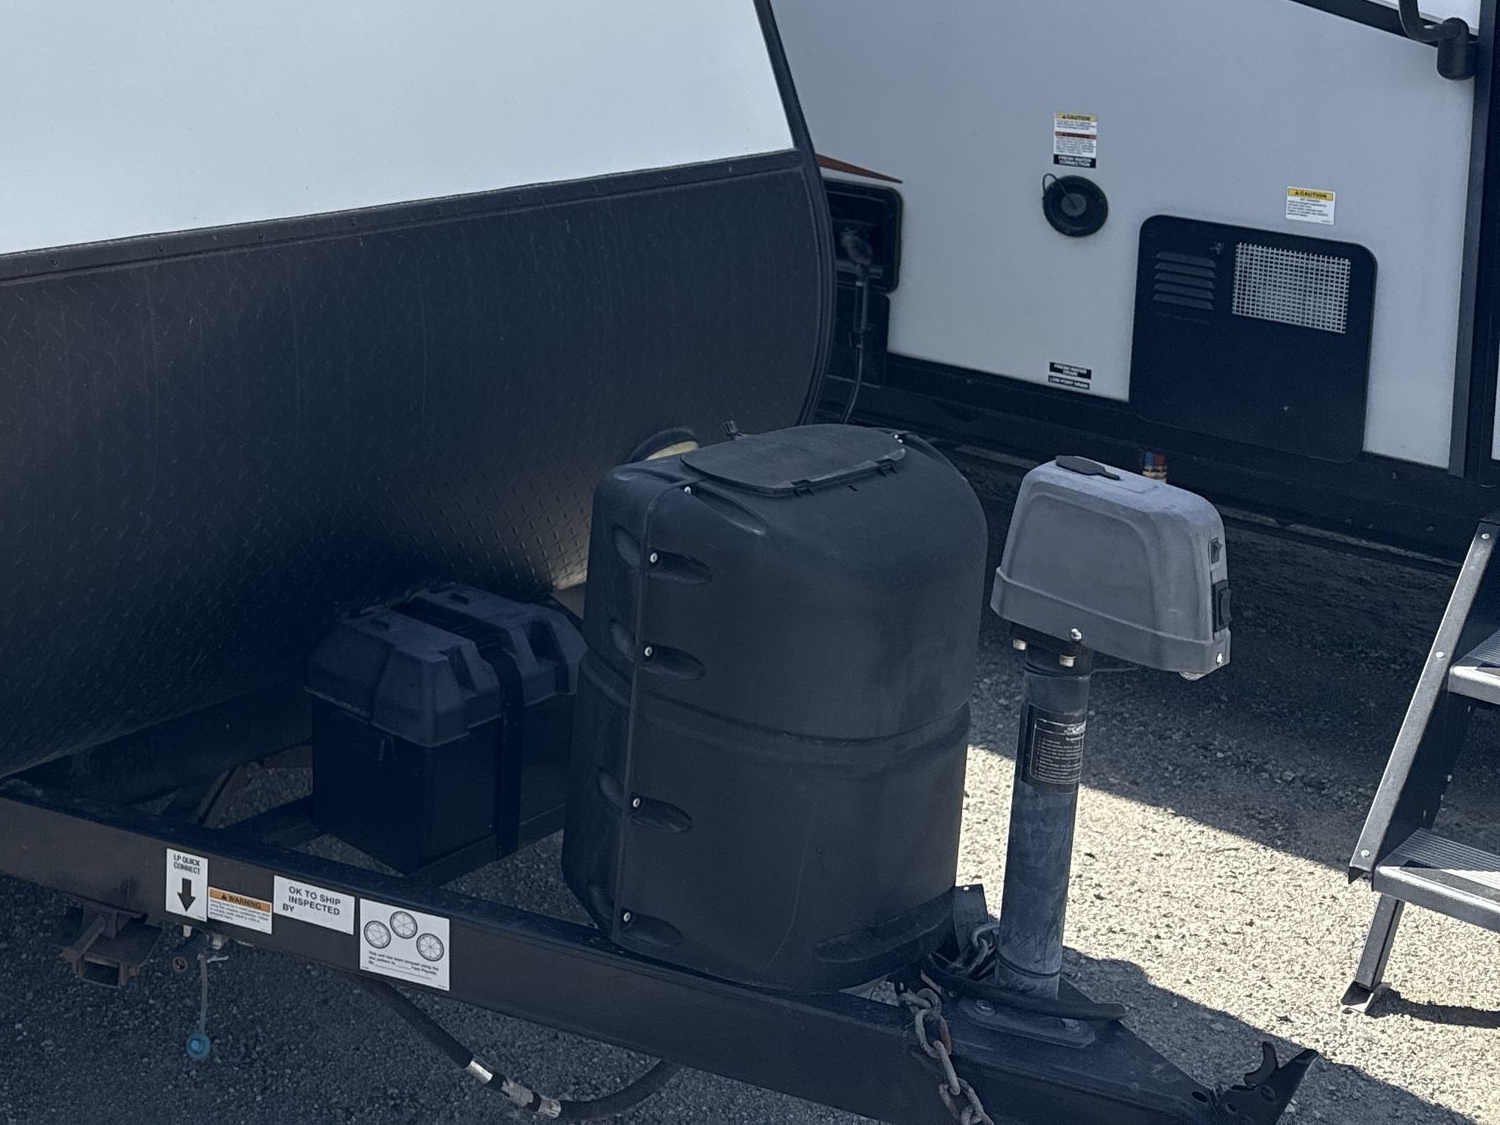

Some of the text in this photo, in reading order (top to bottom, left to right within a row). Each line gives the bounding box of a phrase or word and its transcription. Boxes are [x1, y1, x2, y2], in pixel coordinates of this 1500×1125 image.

[173, 853, 201, 866] LP QUICK
[173, 862, 201, 875] CONNECT
[228, 895, 261, 909] WARNING
[288, 886, 341, 905] OK TO SHIP
[282, 903, 295, 912] BY
[288, 895, 341, 916] INSPECTED
